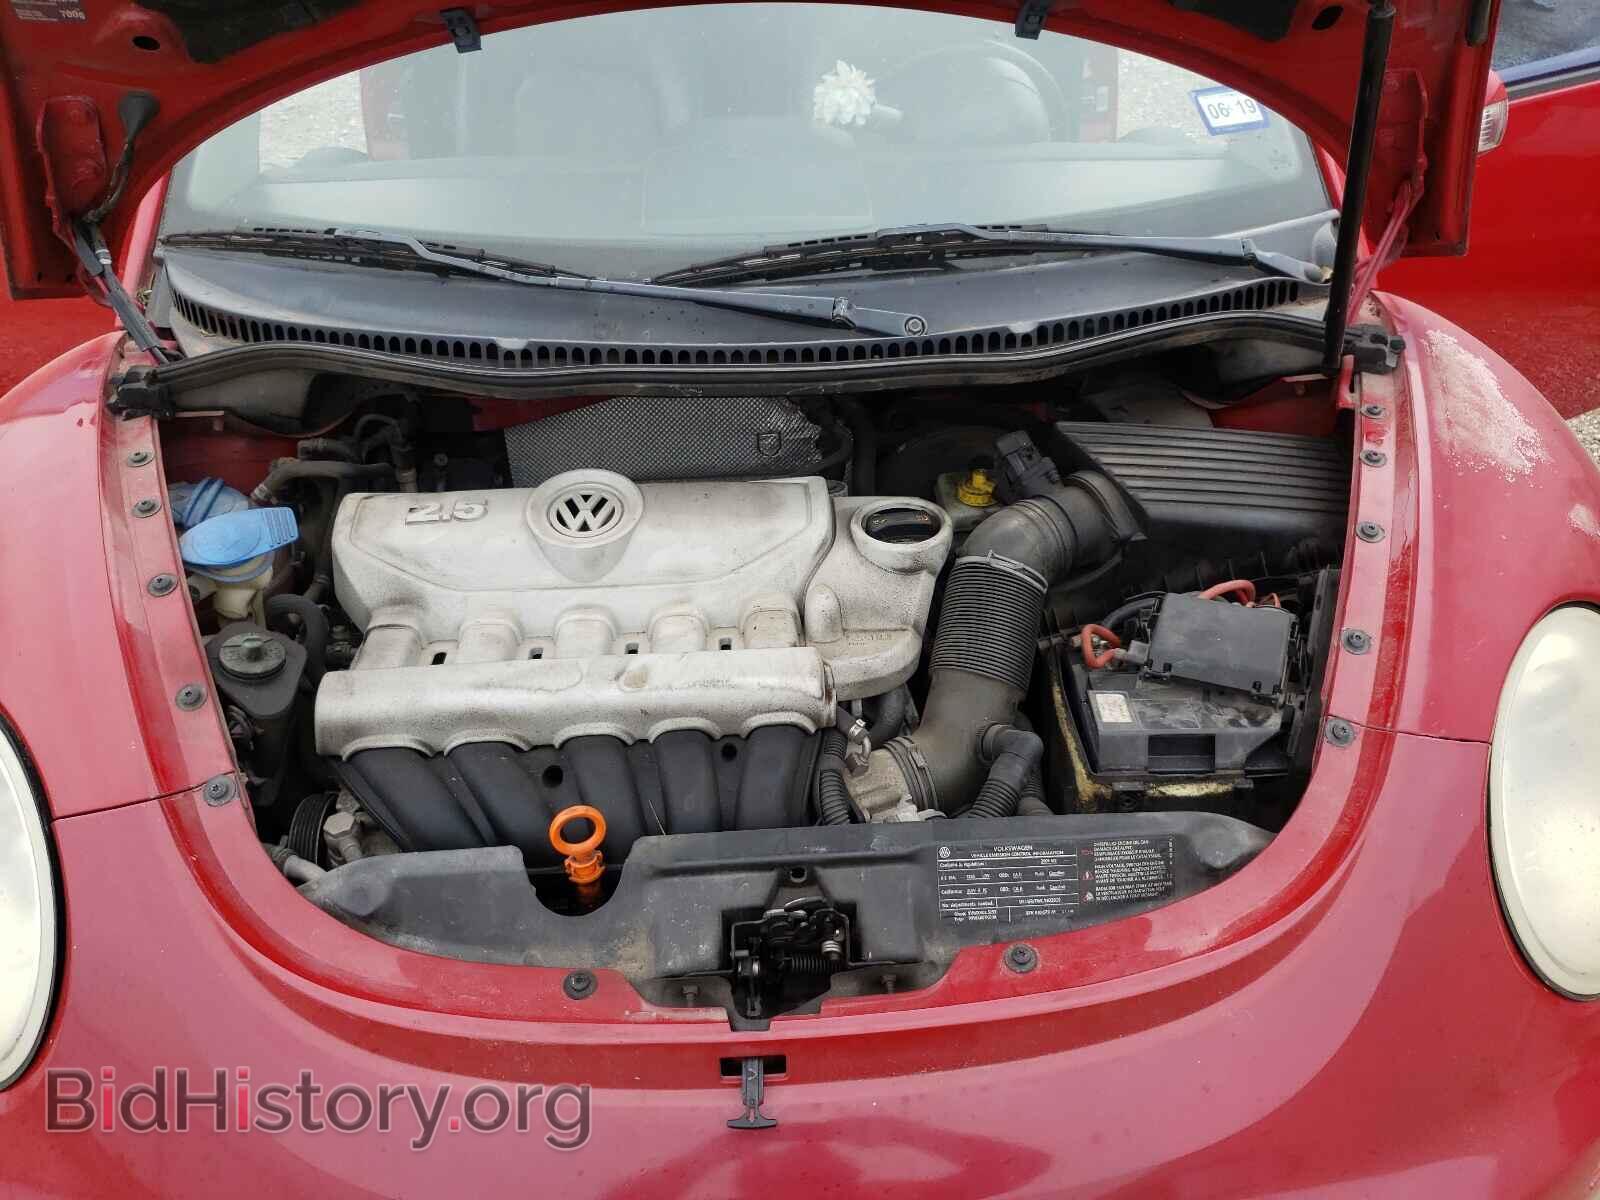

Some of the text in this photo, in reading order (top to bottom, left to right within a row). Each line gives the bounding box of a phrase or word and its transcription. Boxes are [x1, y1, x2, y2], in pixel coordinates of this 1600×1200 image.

[1208, 98, 1257, 119] 06 19
[404, 499, 489, 526] 2.5
[549, 483, 624, 538] VW
